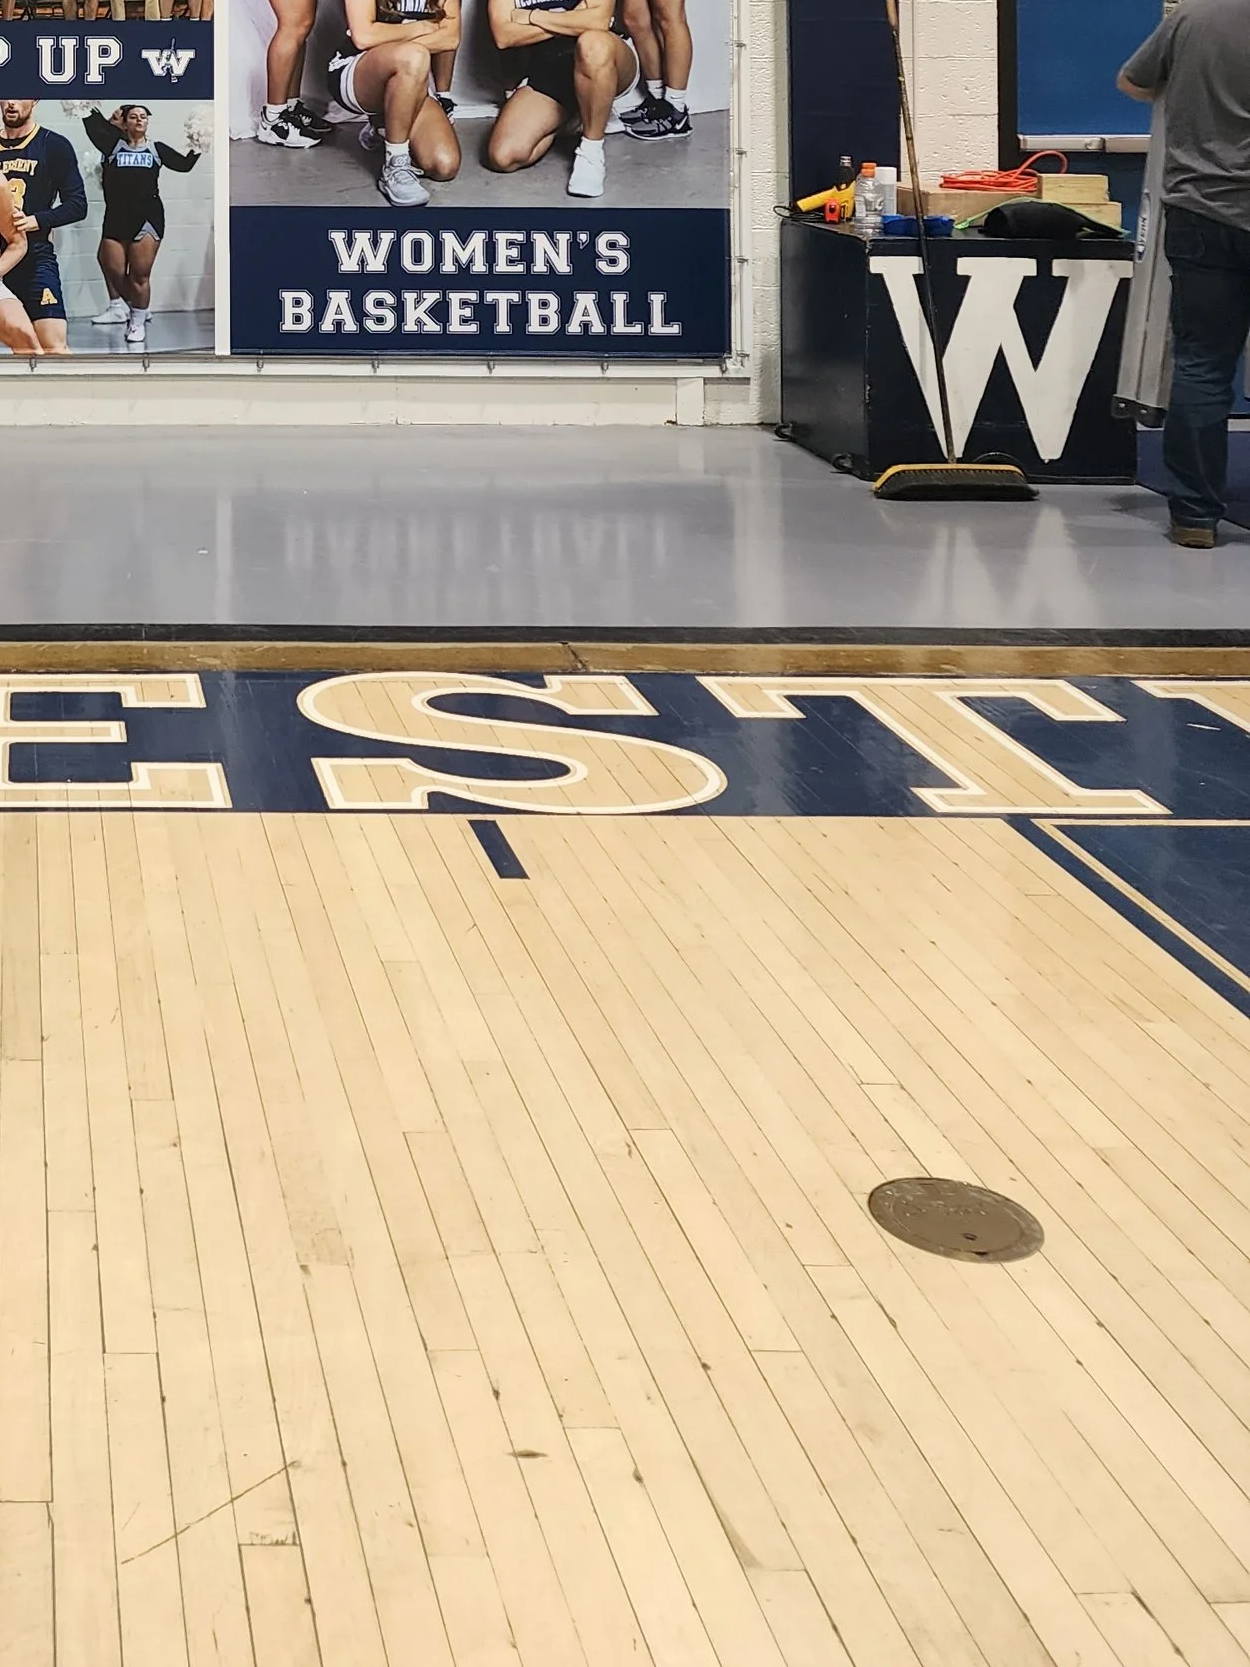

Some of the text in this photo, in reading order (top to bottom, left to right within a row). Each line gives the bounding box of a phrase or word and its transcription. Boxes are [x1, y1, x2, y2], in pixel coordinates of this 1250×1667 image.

[36, 36, 123, 85] UP
[141, 48, 196, 77] W
[117, 152, 153, 167] TITANS
[328, 230, 631, 276] WOMEN'S
[40, 287, 58, 306] A
[279, 289, 682, 336] BASKETBALL
[869, 256, 1133, 462] W
